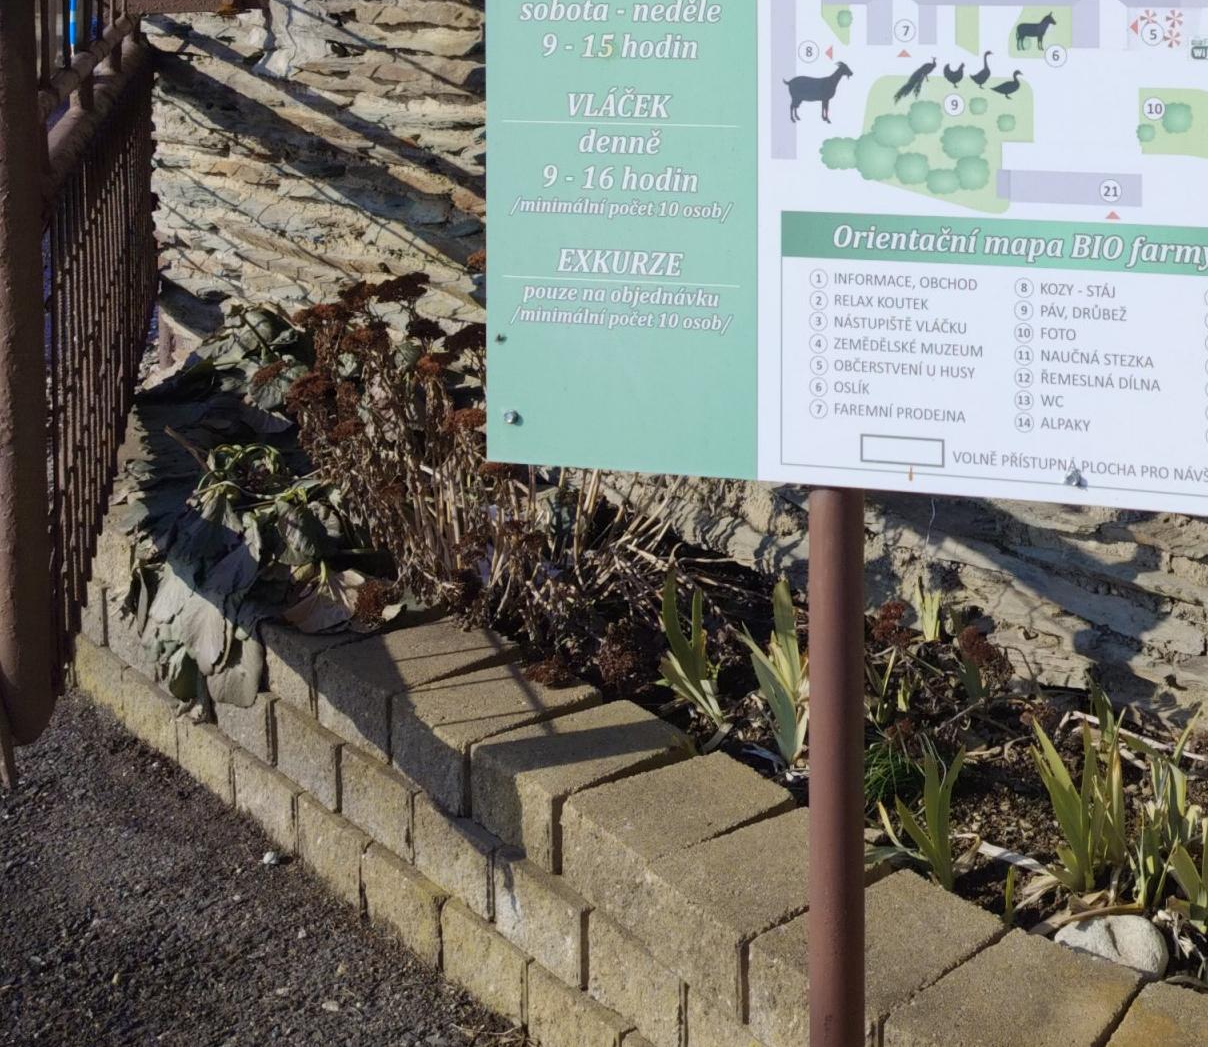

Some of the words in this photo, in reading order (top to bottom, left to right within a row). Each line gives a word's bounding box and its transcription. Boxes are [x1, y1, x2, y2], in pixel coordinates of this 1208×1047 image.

[542, 34, 557, 57] 9
[581, 34, 615, 58] 15
[620, 33, 699, 60] hodin
[567, 86, 672, 118] VLÁČEK
[578, 129, 661, 155] denně
[542, 165, 558, 188] 9
[581, 166, 614, 191] 16
[620, 166, 699, 193] hodin
[1103, 186, 1118, 197] 21
[607, 198, 653, 219] počet
[658, 200, 678, 217] 10
[832, 224, 980, 255] Orientační
[983, 233, 1064, 264] mapa
[1071, 234, 1125, 261] BIO
[557, 248, 683, 277] EXKURZE
[834, 273, 916, 289] INFORMACE,
[919, 276, 978, 291] OBCHOD
[1040, 283, 1074, 297] KOZY
[1086, 284, 1116, 299] STÁJ
[523, 283, 578, 303] pouze
[582, 286, 605, 303] na
[609, 285, 719, 309] objednávku
[834, 295, 875, 308] RELAX
[877, 296, 929, 310] KOUTEK
[607, 309, 654, 330] počet
[657, 311, 678, 328] 10
[834, 313, 912, 332] NÁSTUPIŠTĚ
[916, 316, 967, 335] VLÁČKU
[1040, 305, 1068, 320] PÁV,
[1072, 305, 1127, 322] DRŮBEŽ
[1017, 328, 1031, 338] 10
[1040, 328, 1076, 341] FOTO
[833, 336, 917, 355] ZEMĚDĚLSKÉ
[921, 342, 983, 357] MUZEUM
[834, 356, 923, 376] OBČERSTVENÍ
[940, 365, 975, 379] HUSY
[1017, 351, 1031, 361] 11
[1040, 347, 1099, 364] NAUČNÁ
[1104, 353, 1154, 368] STEZKA
[834, 378, 870, 394] OSLÍK
[1017, 373, 1031, 383] 12
[1040, 368, 1114, 388] ŘEMESLNÁ
[1118, 375, 1161, 392] DÍLNA
[1017, 396, 1031, 406] 13
[1041, 395, 1064, 408] WC
[834, 403, 893, 418] FAREMNÍ
[896, 407, 966, 423] PRODEJNA
[1017, 418, 1031, 428] 14
[1040, 418, 1091, 432] ALPAKY
[952, 449, 997, 466] VOLNĚ
[1001, 452, 1078, 472] PŘÍSTUPNÁ
[1081, 459, 1136, 476] PLOCHA
[1141, 464, 1169, 480] PRO
